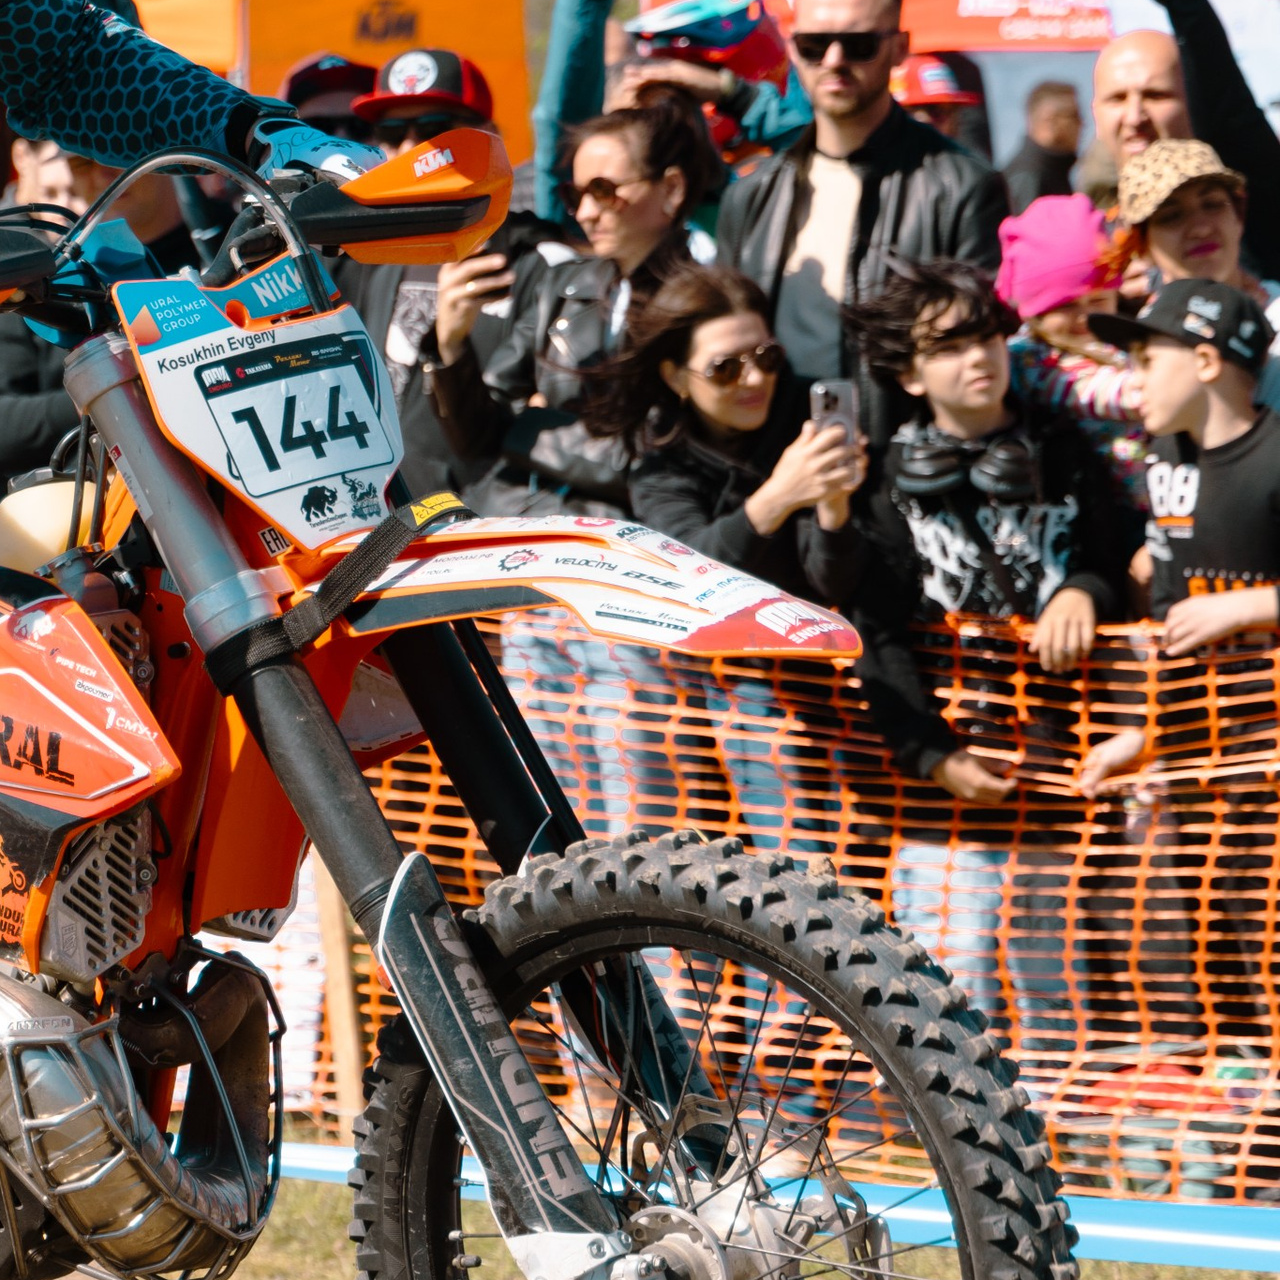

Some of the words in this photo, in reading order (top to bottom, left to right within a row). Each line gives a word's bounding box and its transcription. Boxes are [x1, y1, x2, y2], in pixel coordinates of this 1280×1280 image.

[413, 147, 455, 178] KTM
[149, 295, 181, 311] URAL
[155, 298, 208, 322] POLYMER
[162, 312, 202, 333] GROUP
[157, 343, 226, 374] Kosukhin
[227, 329, 277, 353] Evgeny
[231, 384, 370, 473] 144
[1145, 461, 1201, 519] 88
[554, 553, 618, 571] VELOCITY
[621, 569, 685, 591] BSE
[786, 621, 845, 645] ENDURO
[55, 655, 75, 670] PIPE
[76, 662, 98, 678] TECH
[0, 919, 22, 937] URA
[381, 1084, 417, 1223] MAXXIS
